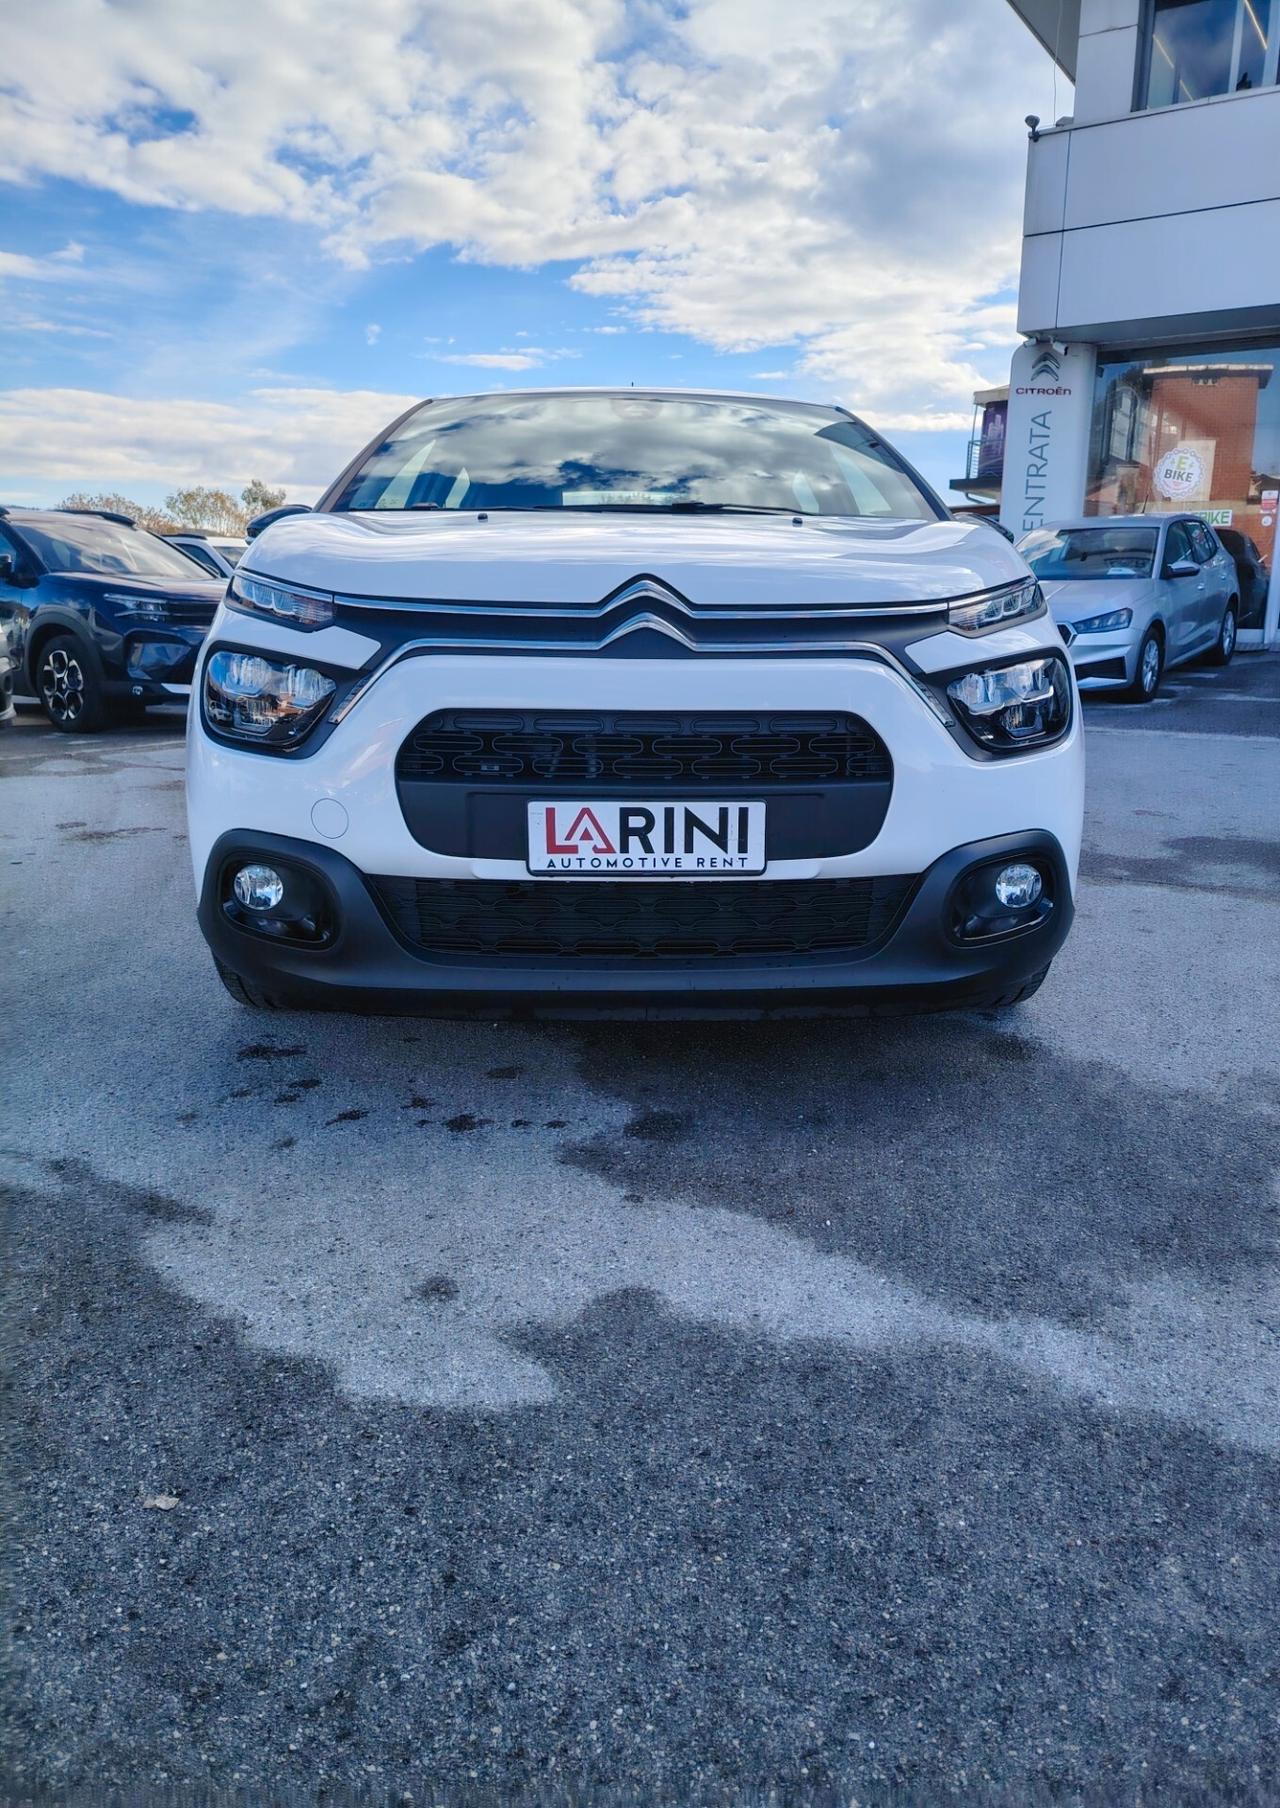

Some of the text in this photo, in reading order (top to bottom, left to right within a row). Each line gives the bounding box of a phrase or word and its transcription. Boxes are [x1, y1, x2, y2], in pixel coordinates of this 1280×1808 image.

[1176, 456, 1189, 470] E
[1022, 410, 1052, 532] ENTRATA
[1164, 468, 1194, 483] BIKE
[545, 807, 749, 855] LARINI
[547, 857, 749, 869] AUTOMOTIVE RENT
